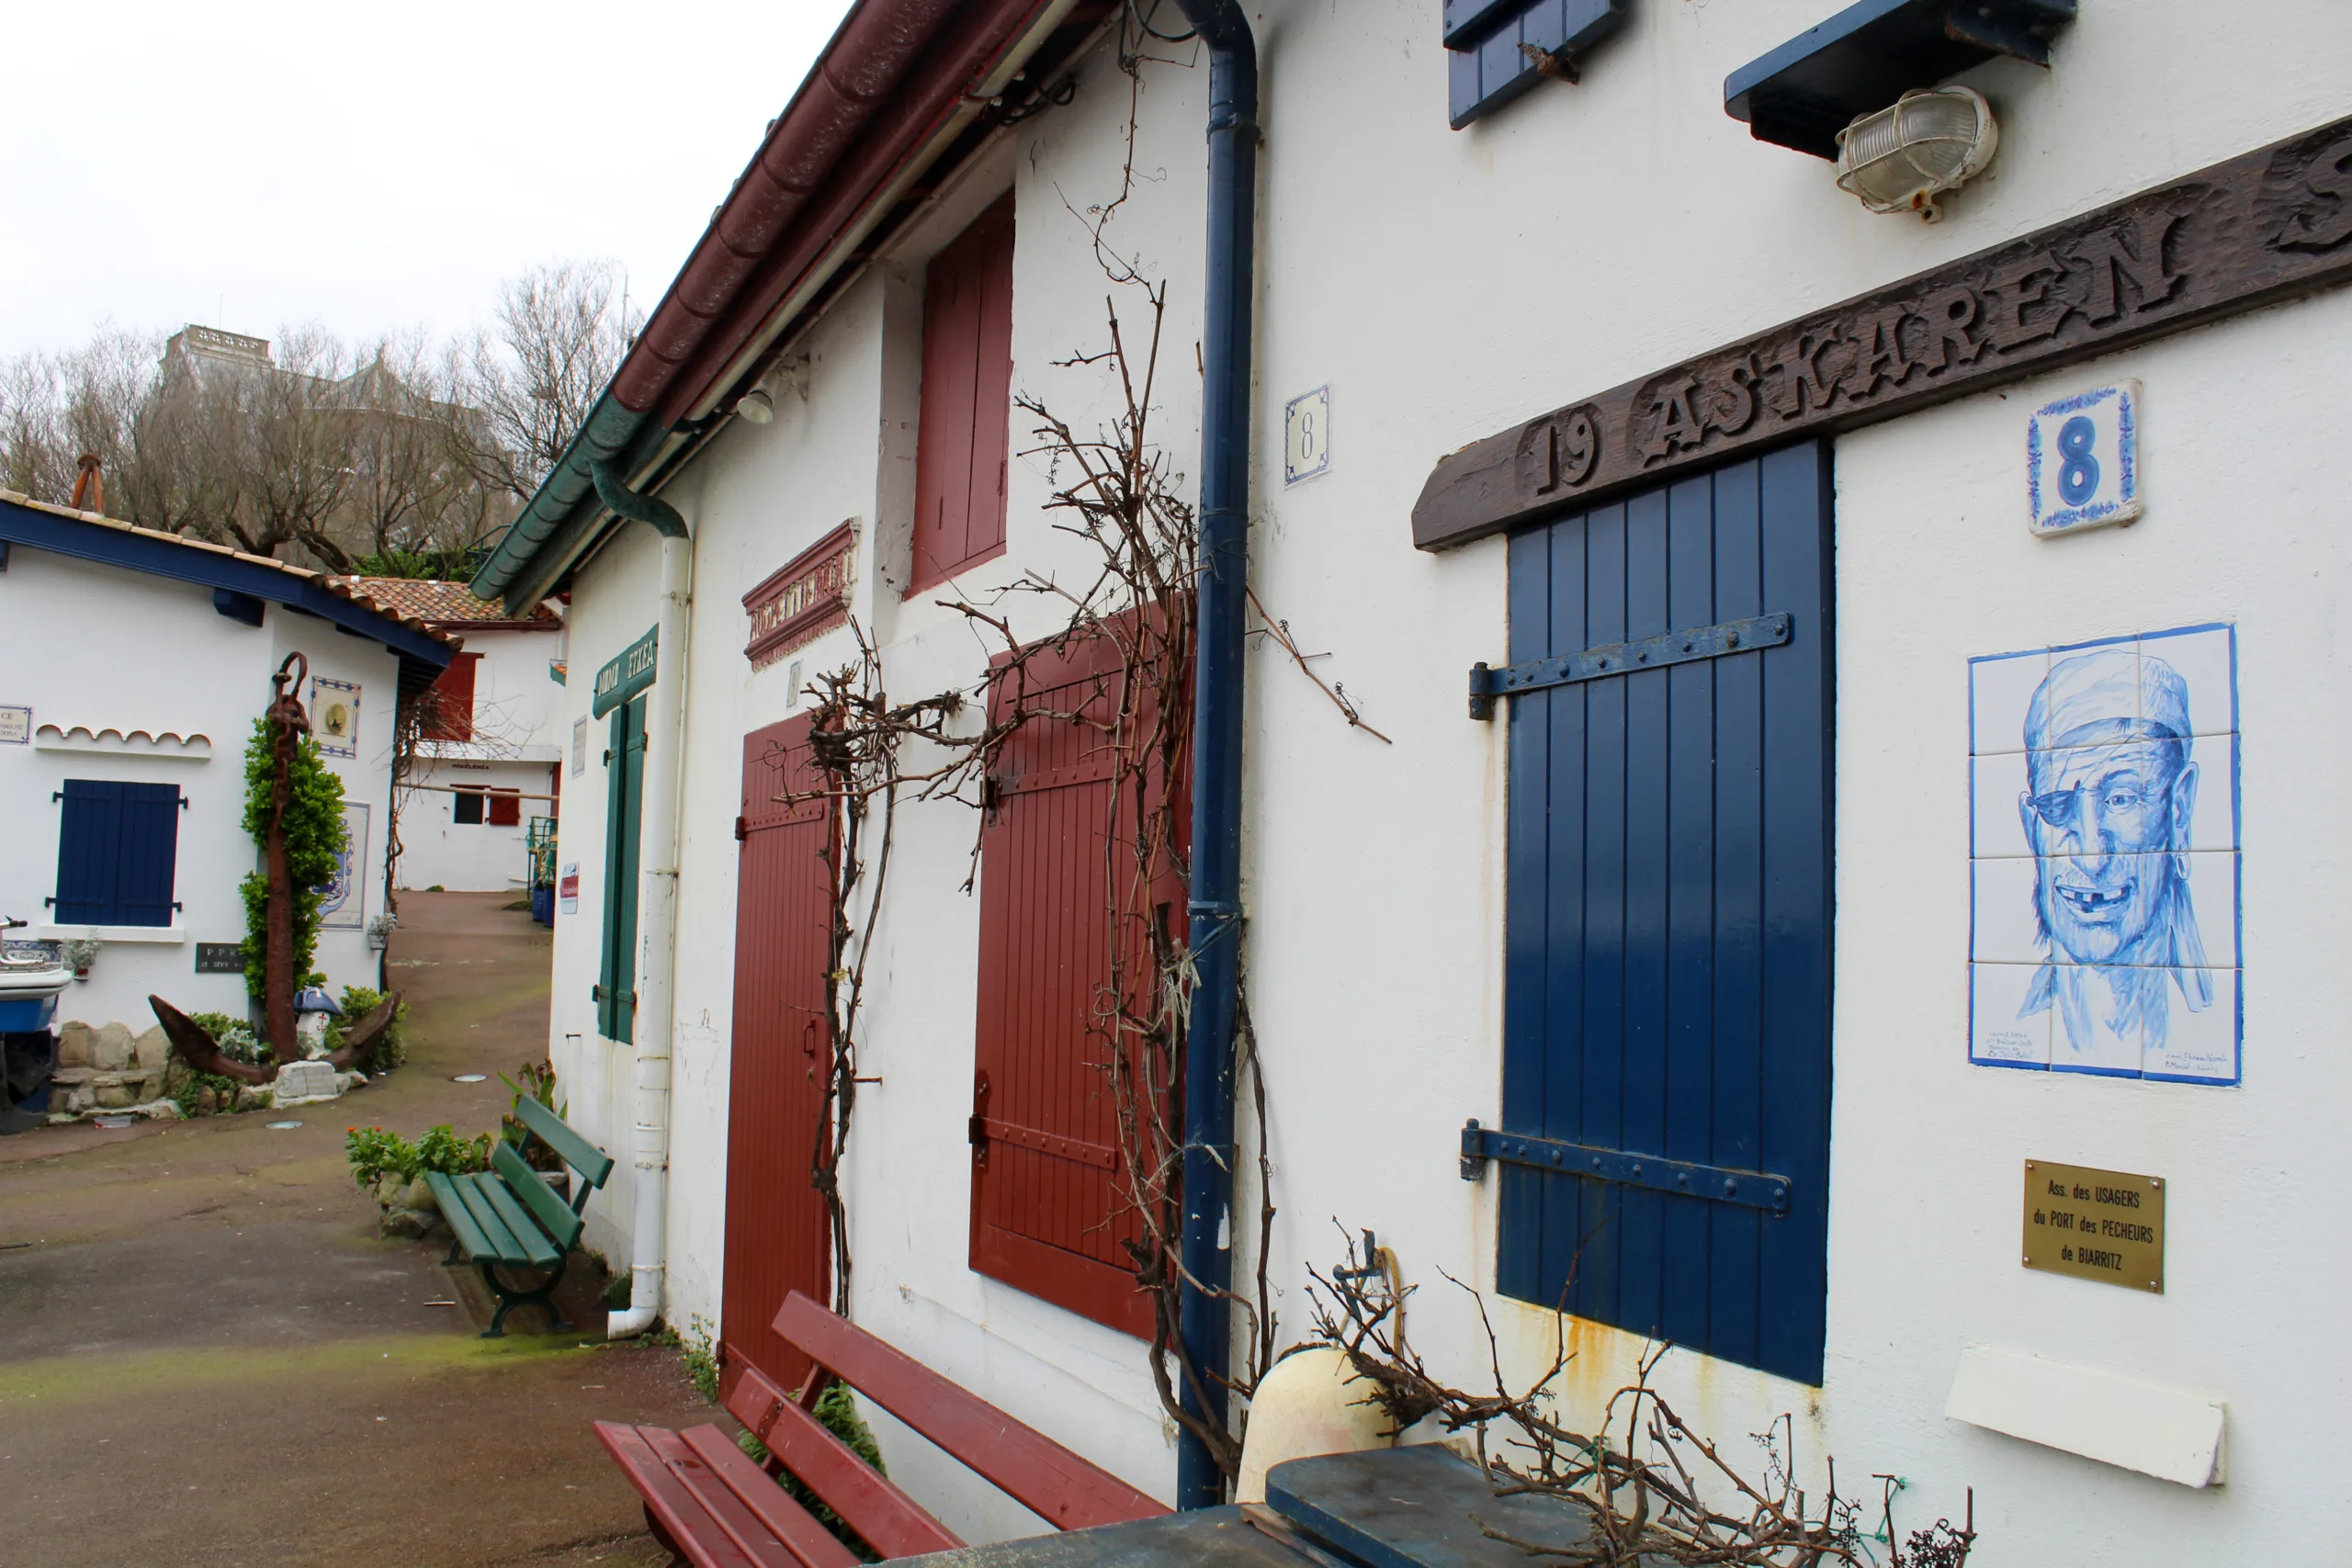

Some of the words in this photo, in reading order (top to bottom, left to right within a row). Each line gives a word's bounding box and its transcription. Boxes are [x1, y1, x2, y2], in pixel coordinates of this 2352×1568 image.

[1521, 412, 1600, 497] 19
[1637, 209, 2193, 469] ASKAREN
[1301, 412, 1313, 460] 8
[2057, 415, 2101, 508] 8
[2048, 1179, 2068, 1198] Ass.
[2073, 1182, 2090, 1201] des
[2095, 1185, 2141, 1210] USAGERS
[2033, 1208, 2046, 1225] du
[2050, 1210, 2075, 1230] PORT
[2079, 1215, 2098, 1235] des
[2101, 1218, 2154, 1245] PECHEURS
[2061, 1244, 2074, 1261] de
[2078, 1247, 2122, 1271] BIARRITZ
